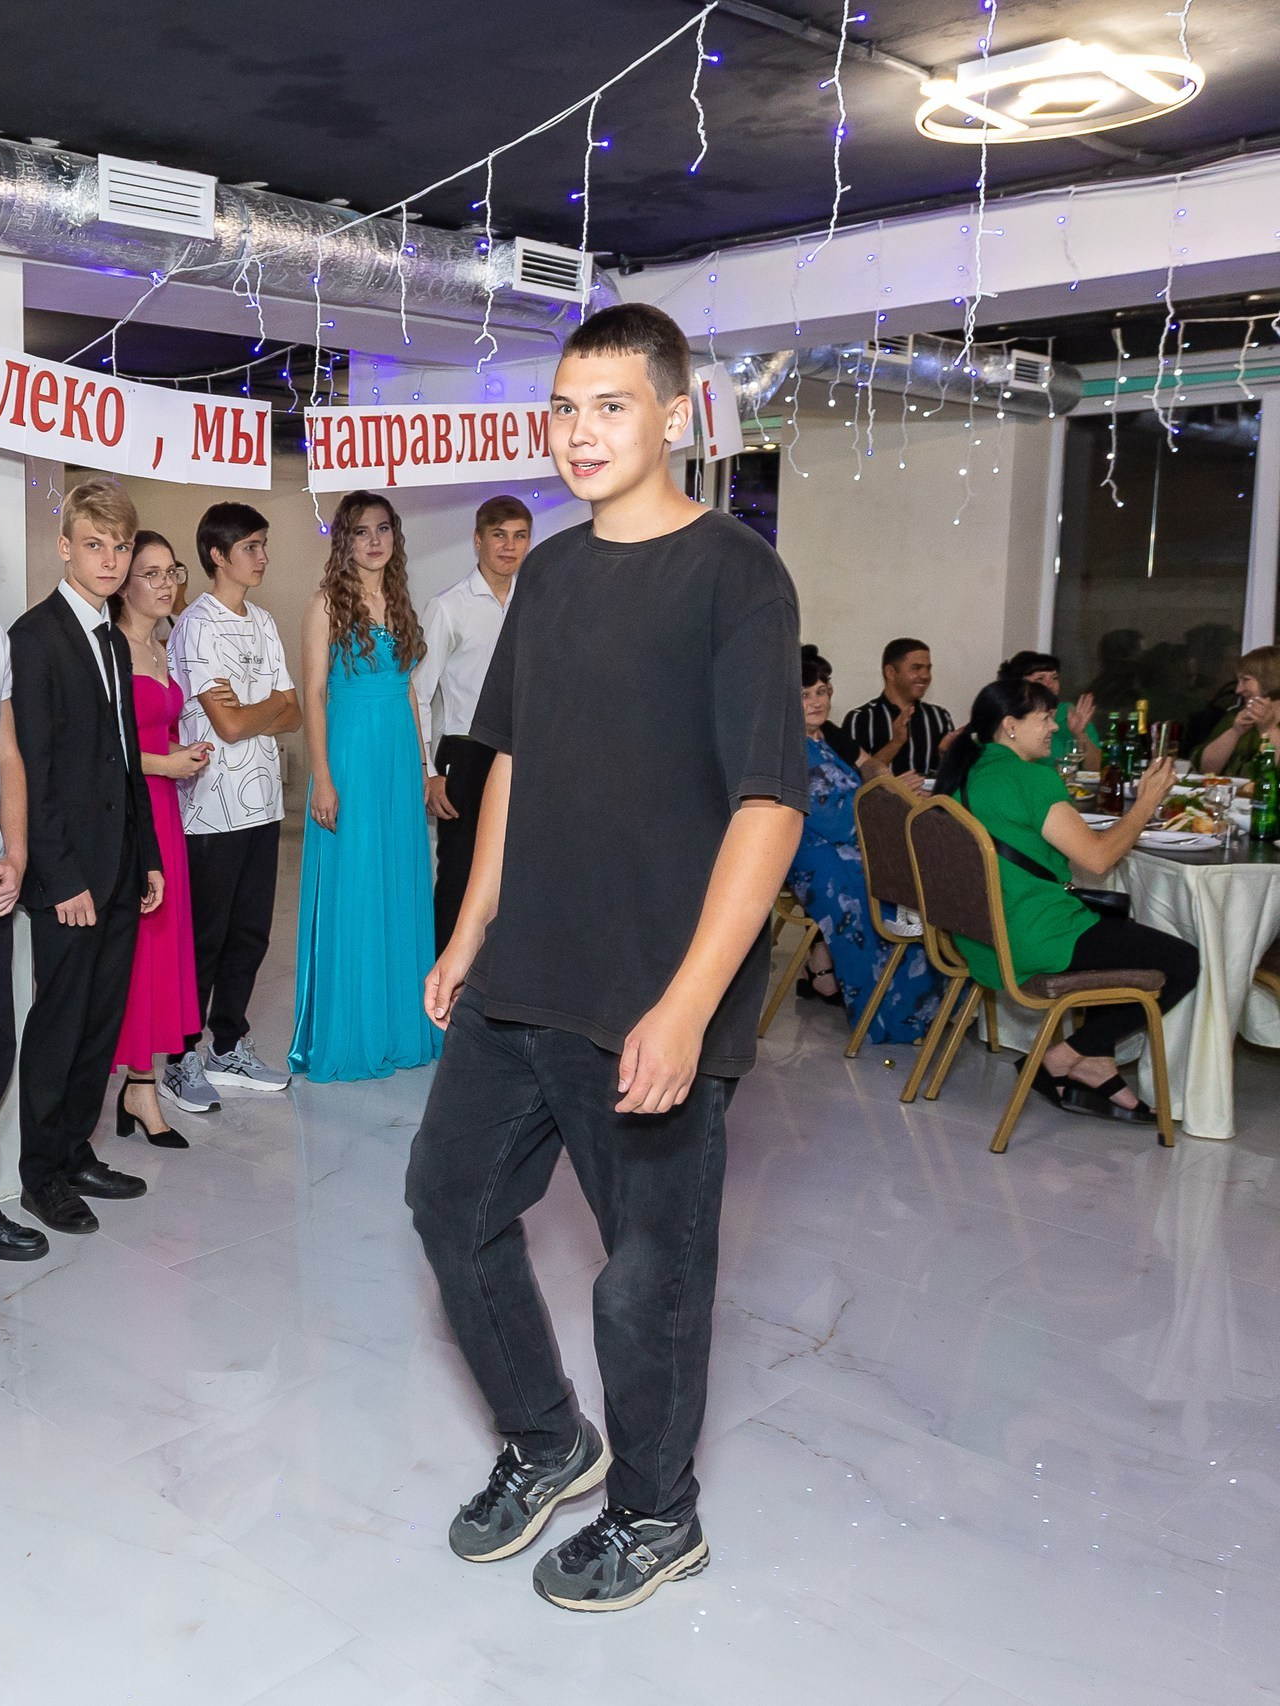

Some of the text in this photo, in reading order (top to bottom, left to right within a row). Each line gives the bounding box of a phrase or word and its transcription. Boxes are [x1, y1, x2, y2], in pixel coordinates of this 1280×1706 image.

[191, 403, 268, 466] мы
[307, 411, 550, 486] направляем
[702, 380, 718, 457] !
